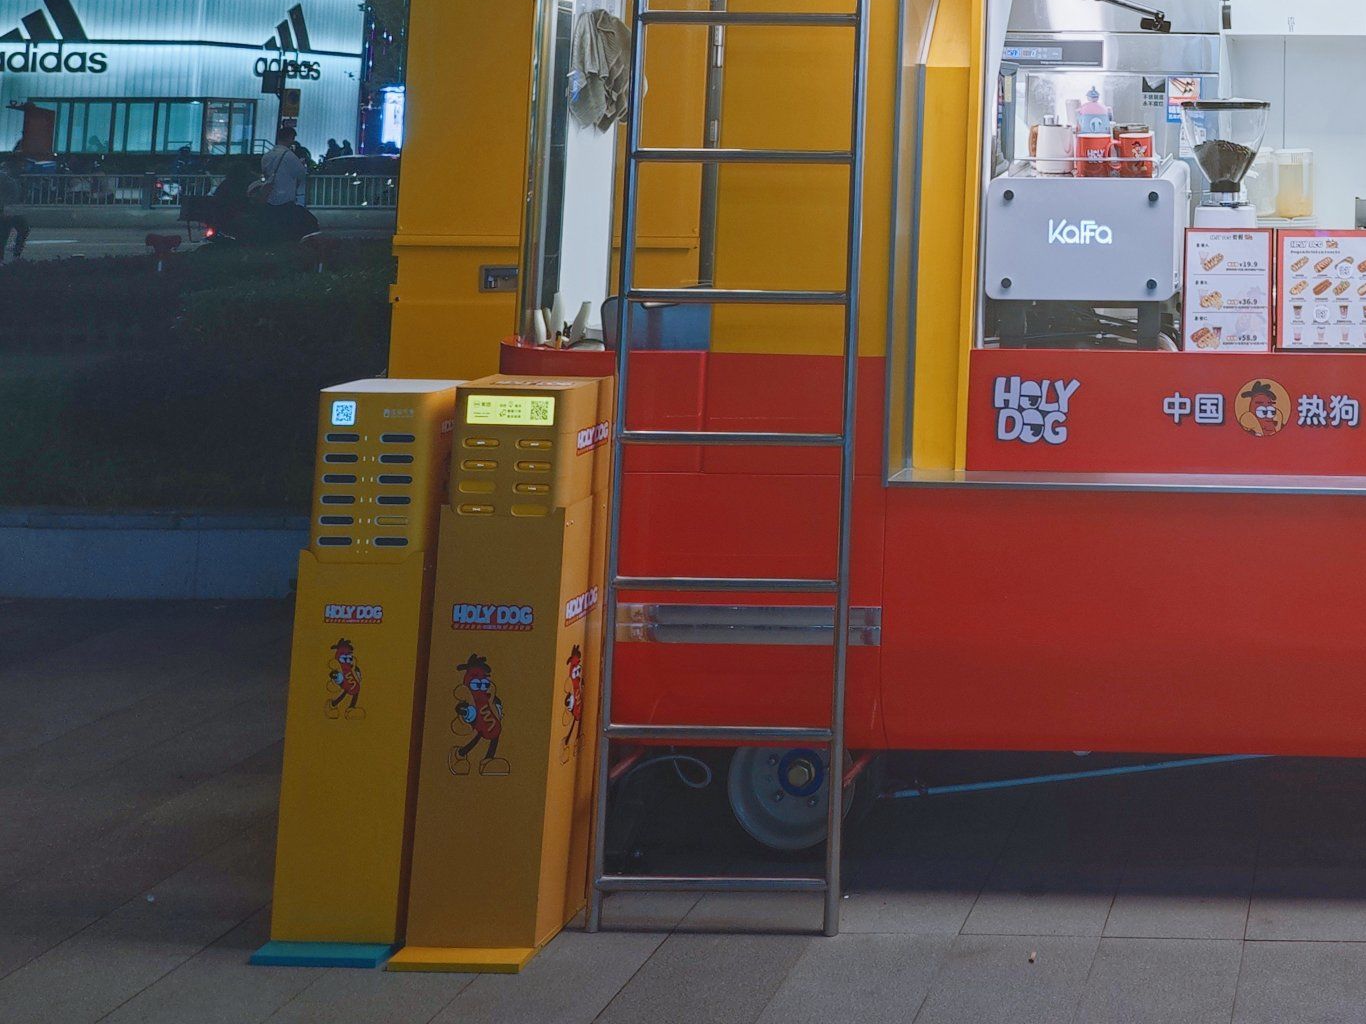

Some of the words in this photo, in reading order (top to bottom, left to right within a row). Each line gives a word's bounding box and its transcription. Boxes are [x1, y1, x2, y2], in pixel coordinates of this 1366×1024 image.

[994, 376, 1080, 414] HOLY
[1162, 391, 1224, 424] 中国
[1297, 394, 1360, 427] 热狗
[577, 426, 595, 449] HOLY
[997, 408, 1067, 444] DOG
[325, 605, 354, 619] HOLY
[356, 605, 383, 619] DOG
[453, 604, 496, 623] HOLY
[497, 605, 533, 624] DOG
[565, 592, 585, 619] HOLY
